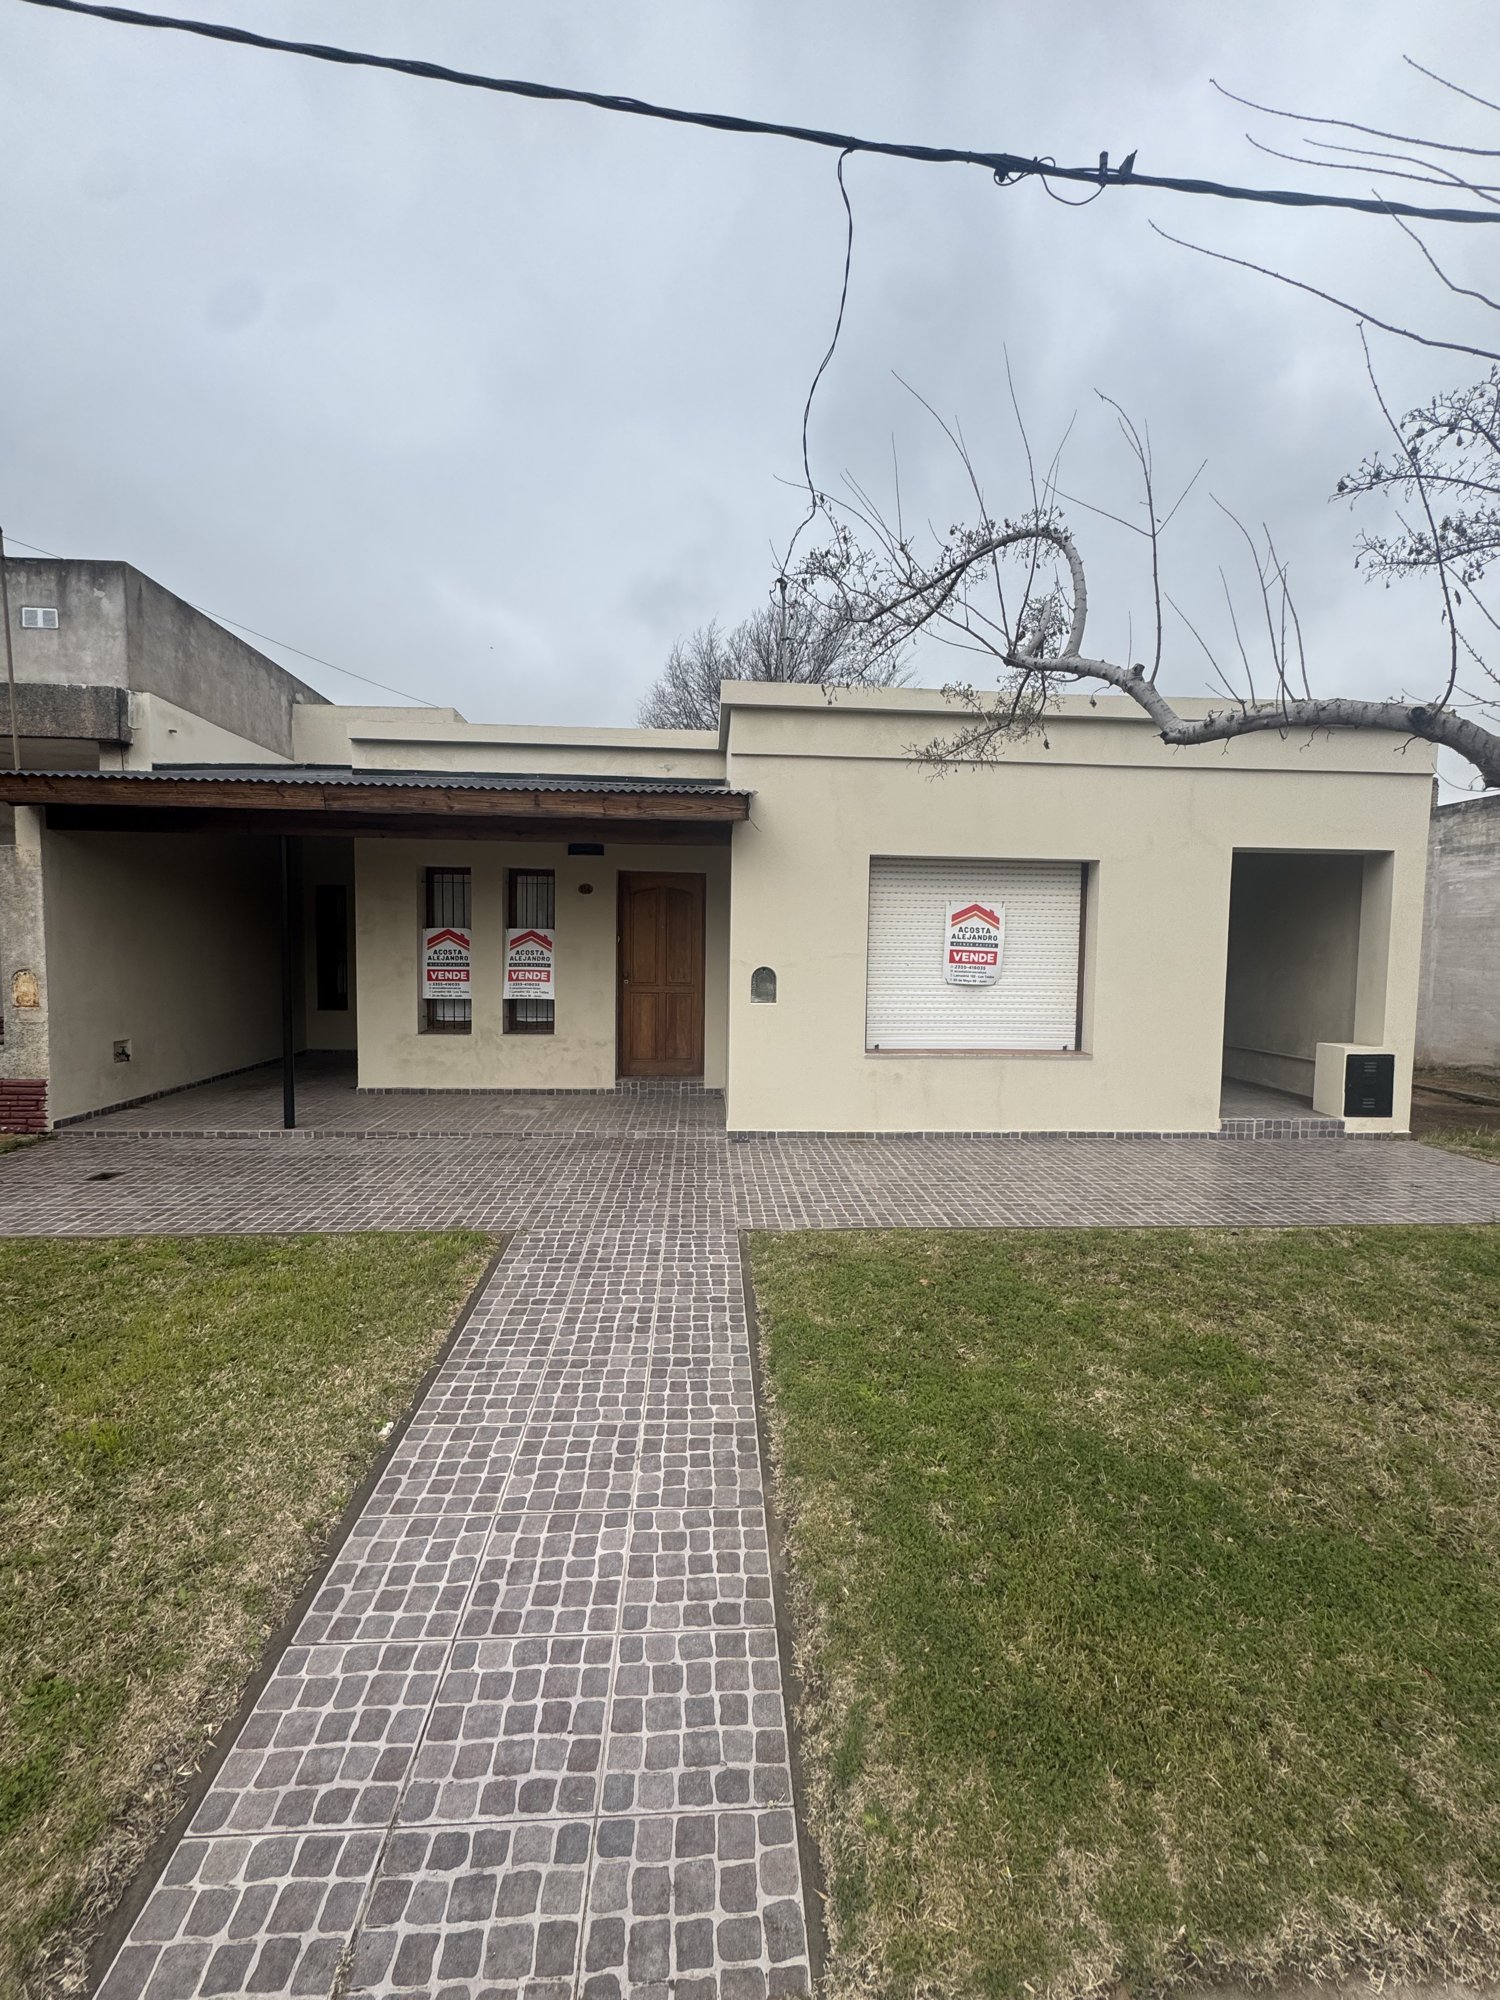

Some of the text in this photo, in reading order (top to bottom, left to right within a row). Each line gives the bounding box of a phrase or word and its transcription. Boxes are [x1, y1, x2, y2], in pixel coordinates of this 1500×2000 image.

[958, 926, 991, 934] ACOSTA
[951, 933, 998, 941] ALEJANDRO
[952, 951, 995, 963] VENDE
[430, 971, 467, 980] VENDE
[511, 971, 548, 980] VENDE
